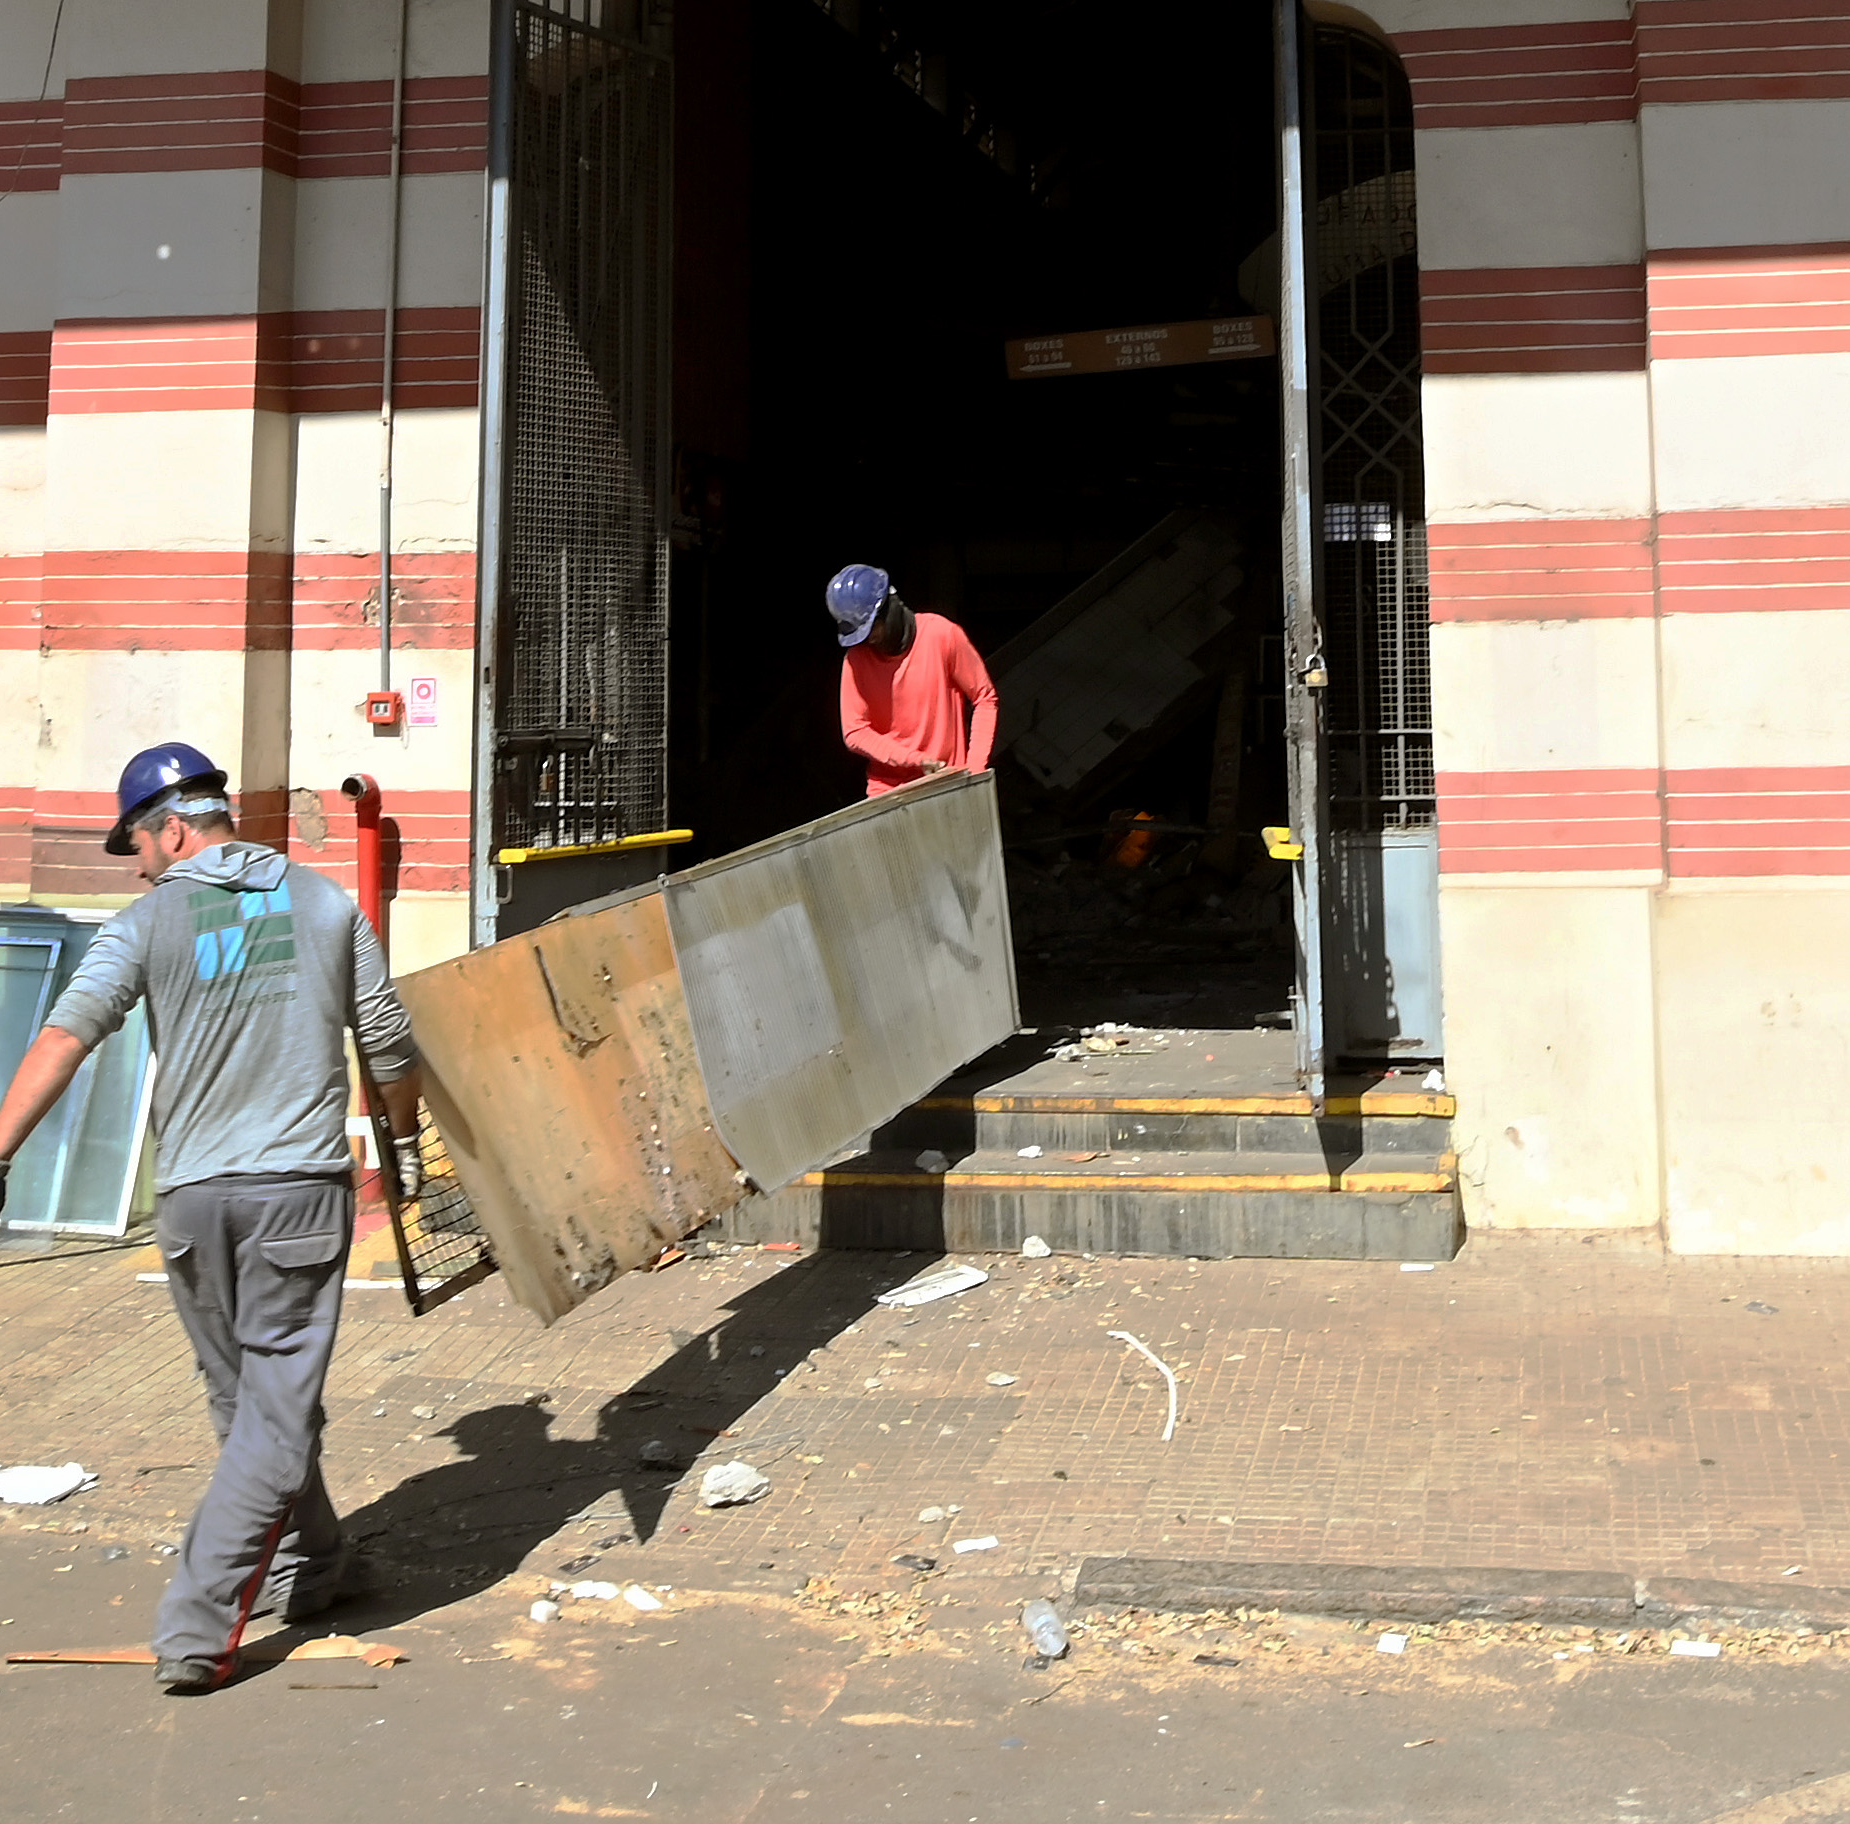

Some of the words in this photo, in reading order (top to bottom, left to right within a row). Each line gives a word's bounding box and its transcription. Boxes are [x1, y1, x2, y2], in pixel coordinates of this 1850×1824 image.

[1212, 321, 1253, 335] BOXES
[1105, 328, 1169, 345] EXTERNOS
[1024, 338, 1064, 353] BOXES
